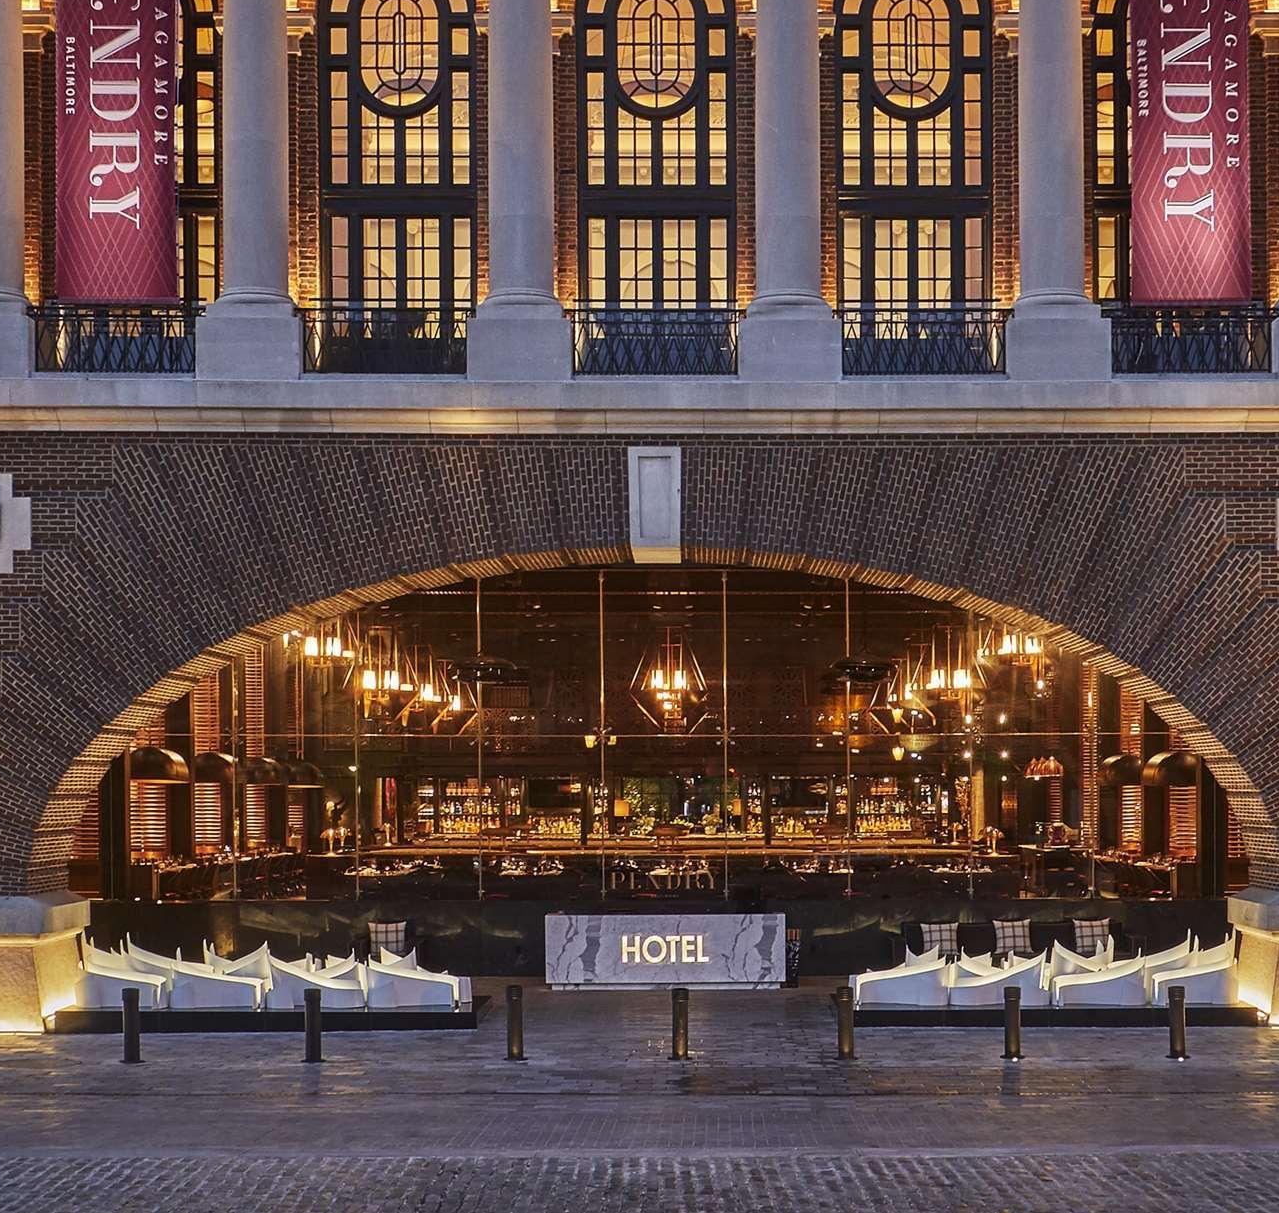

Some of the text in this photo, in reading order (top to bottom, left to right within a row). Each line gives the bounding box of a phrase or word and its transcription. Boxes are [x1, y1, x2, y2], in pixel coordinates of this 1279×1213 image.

[65, 36, 76, 115] BALTIMORE
[1136, 38, 1149, 117] BALTIMORE
[620, 935, 710, 964] HOTEL
